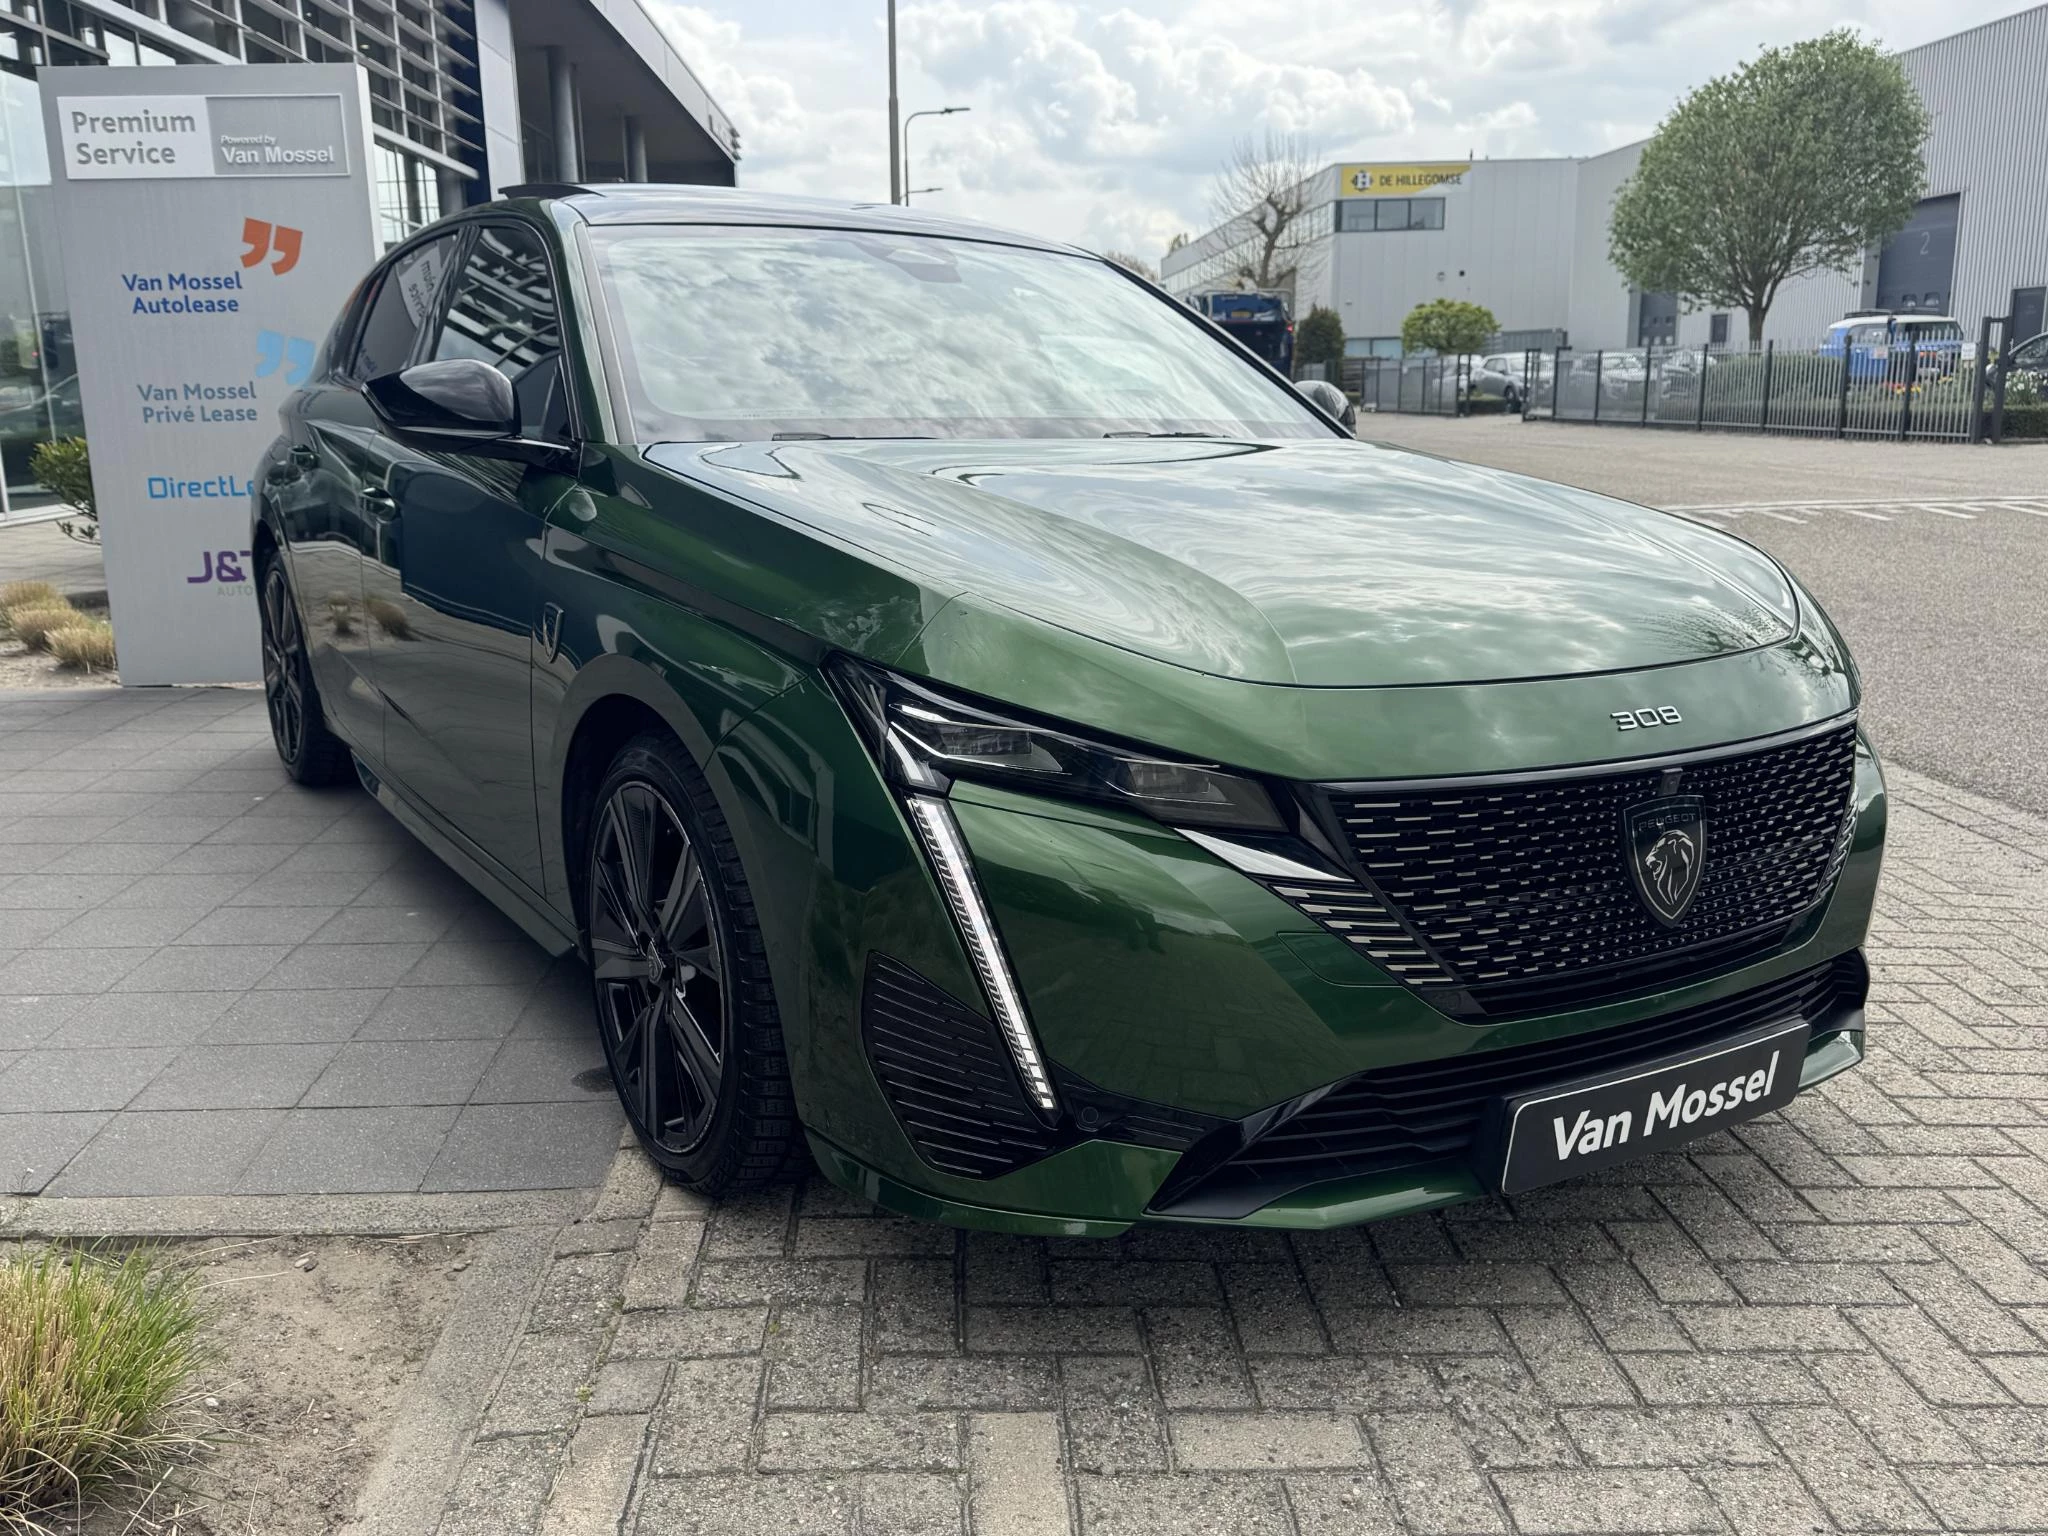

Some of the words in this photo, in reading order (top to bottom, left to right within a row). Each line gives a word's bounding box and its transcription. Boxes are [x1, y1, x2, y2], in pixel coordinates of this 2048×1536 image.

[71, 109, 196, 134] Premium
[220, 134, 263, 145] Powered
[264, 134, 277, 145] by
[76, 141, 175, 165] Service
[221, 146, 260, 163] Van
[265, 145, 335, 163] Mossel
[1379, 174, 1393, 187] DE
[1395, 172, 1463, 187] HILLEGOMSE
[1920, 231, 1930, 255] 2
[121, 273, 161, 291] Van
[168, 271, 243, 292] Mossel
[132, 295, 239, 315] Autolease
[137, 384, 178, 401] Van
[183, 381, 257, 401] Mossel
[142, 404, 194, 424] Privé
[200, 404, 258, 423] Lease
[187, 550, 251, 584] J&
[1610, 705, 1683, 731] 308
[1637, 812, 1697, 832] PEUGEOT
[1553, 1110, 1633, 1161] Van
[1643, 1050, 1780, 1137] Mossel
